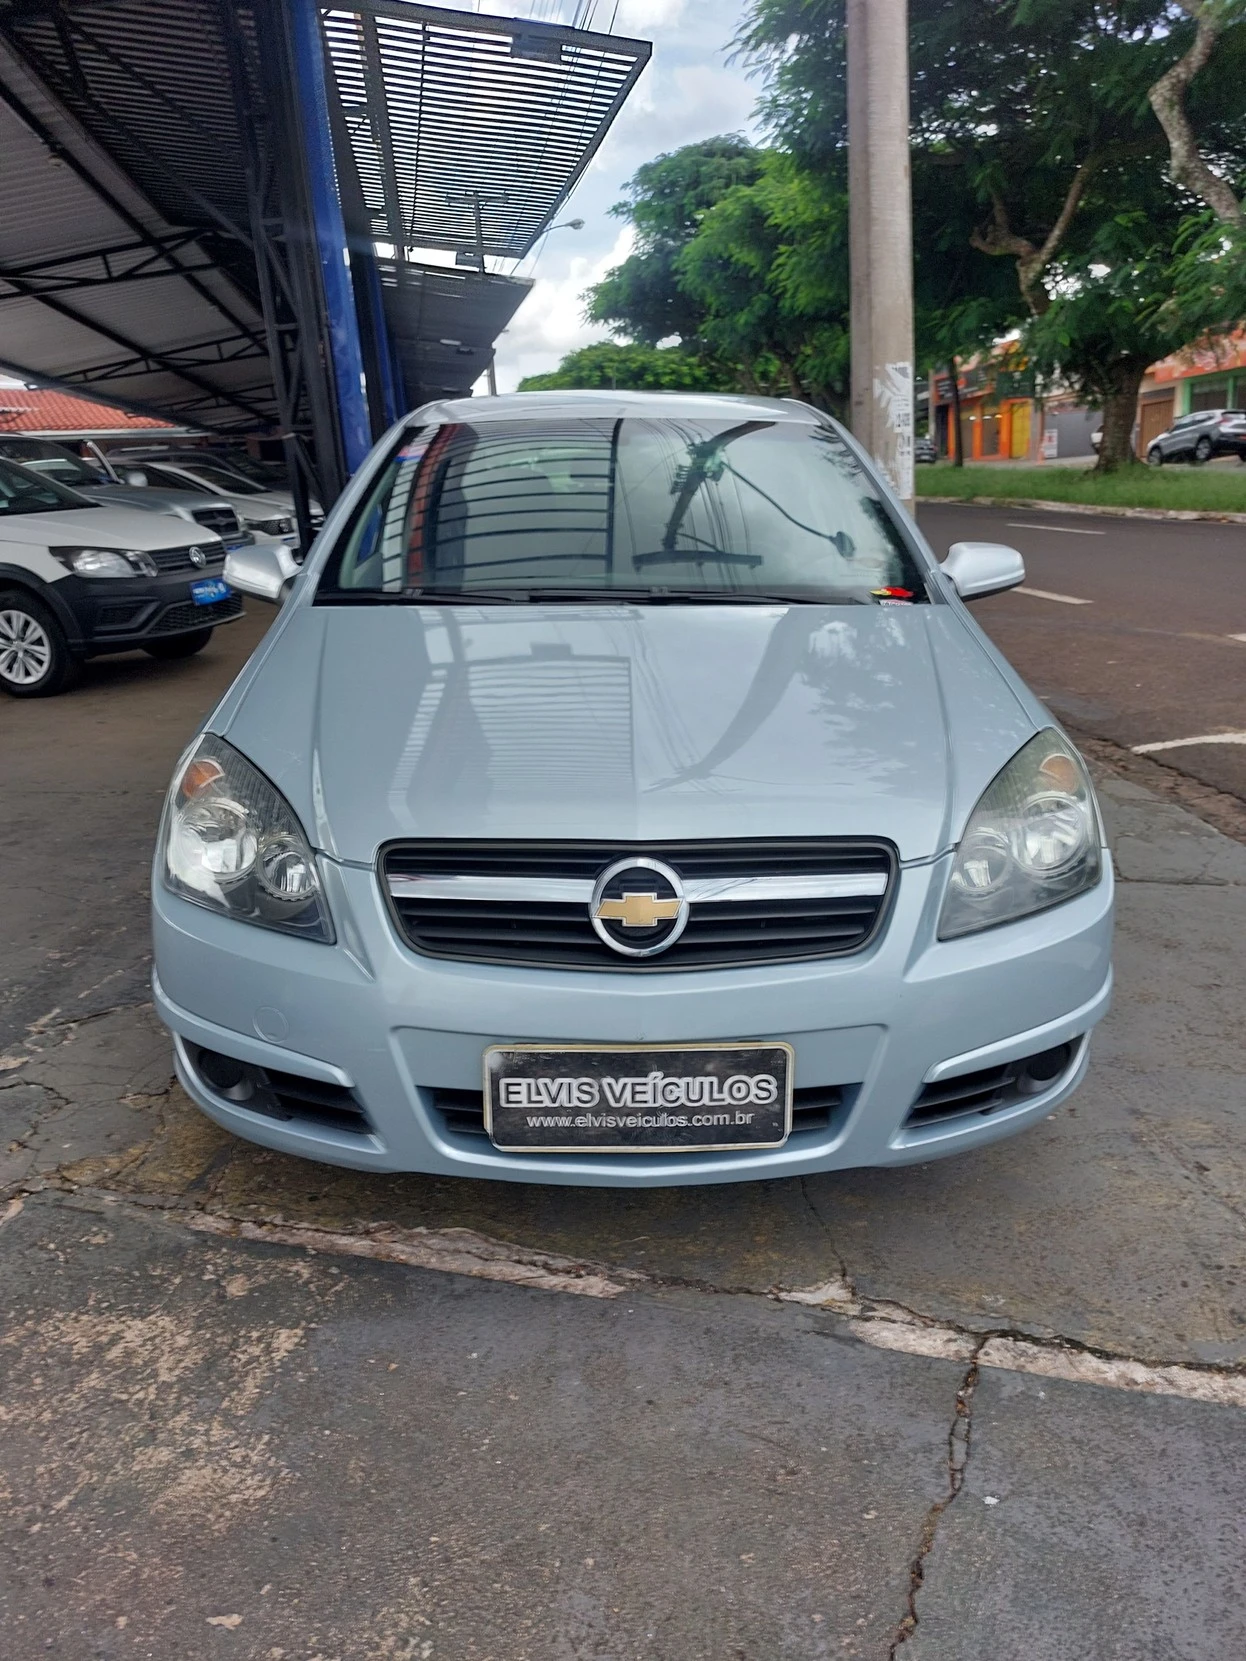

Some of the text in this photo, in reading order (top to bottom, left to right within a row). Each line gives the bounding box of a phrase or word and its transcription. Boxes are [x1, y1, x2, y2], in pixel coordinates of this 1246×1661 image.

[499, 1071, 778, 1108] ELVIS VEÍCULOS
[526, 1110, 755, 1128] www.elvisveiculos.com.br
